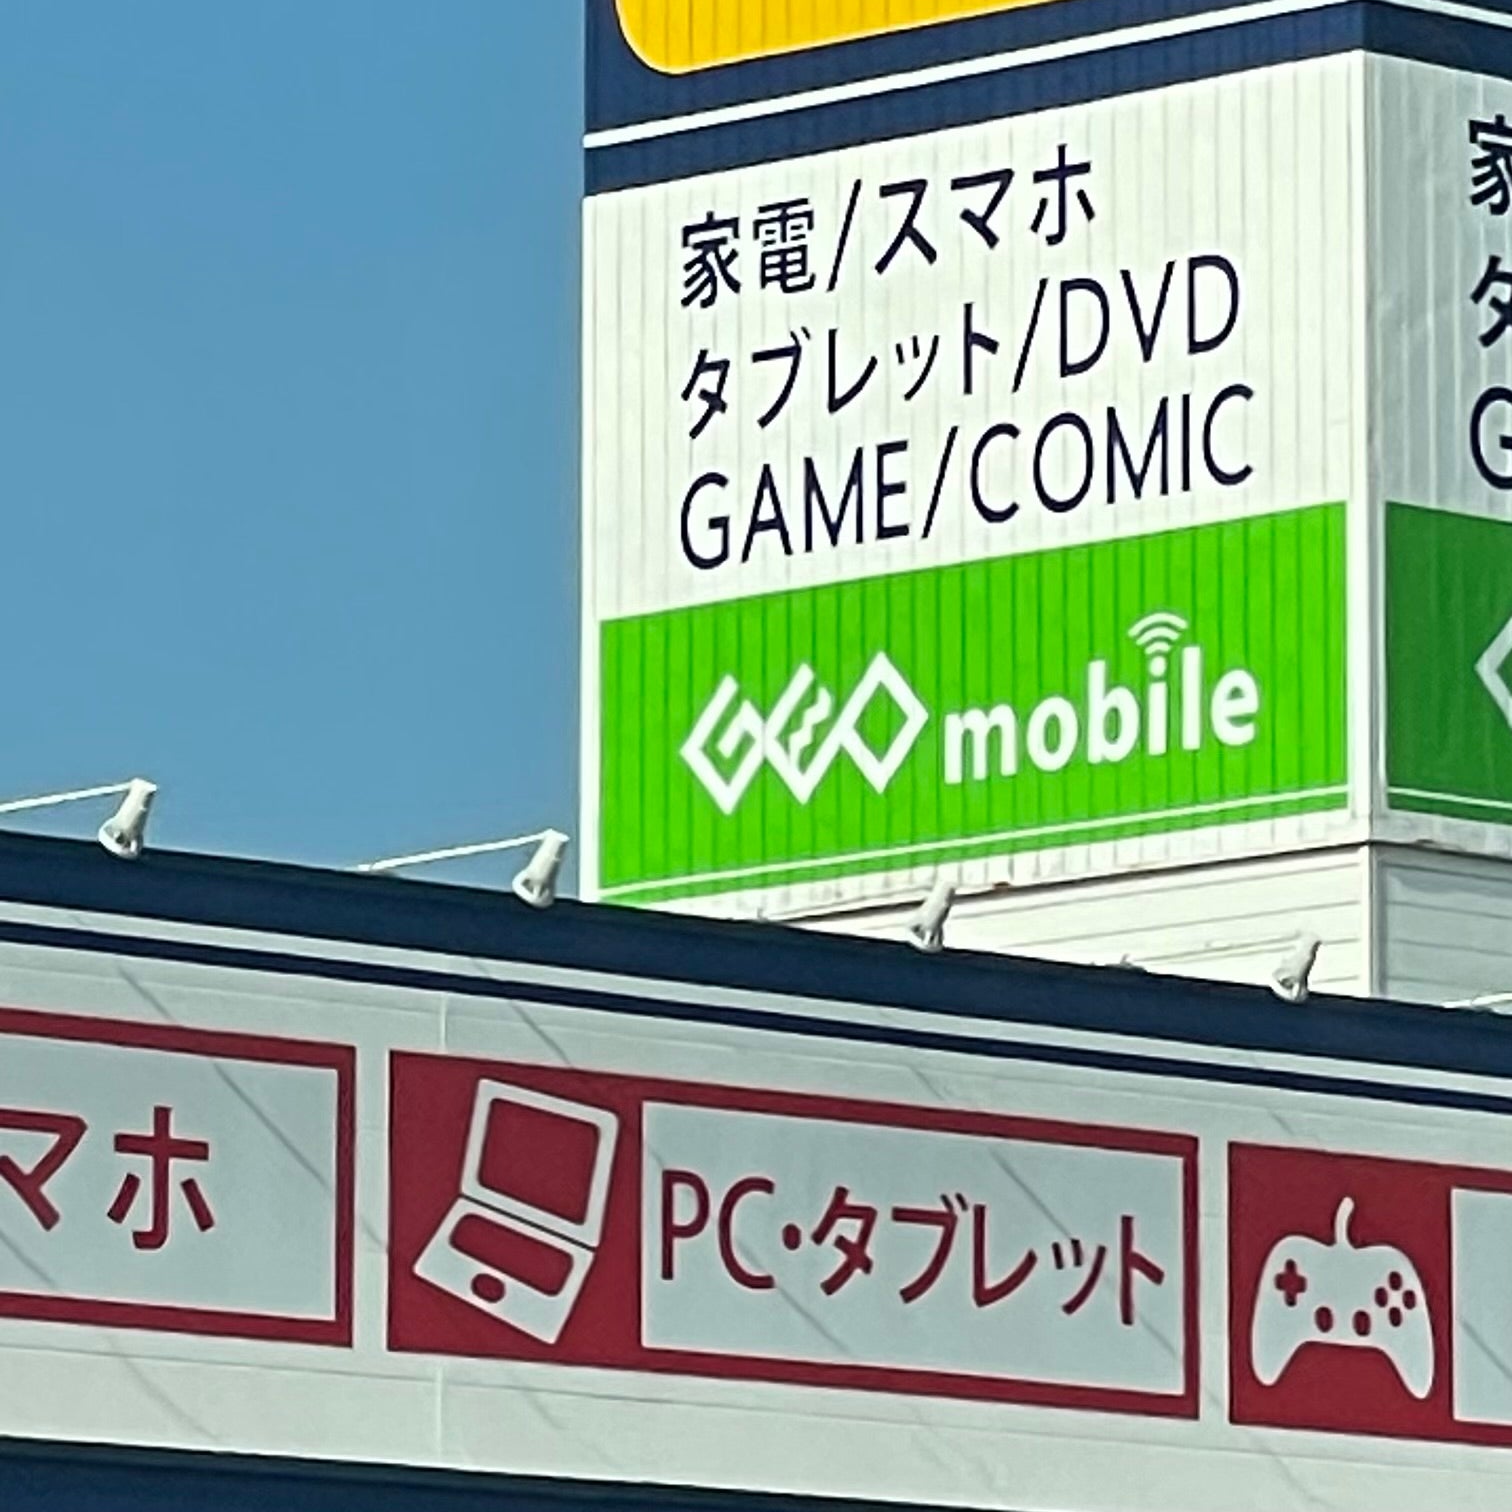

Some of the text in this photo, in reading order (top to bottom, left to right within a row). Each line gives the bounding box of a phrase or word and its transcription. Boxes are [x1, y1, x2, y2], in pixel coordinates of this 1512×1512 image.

[680, 144, 1096, 309] 家電/スマホ
[681, 254, 1241, 440] タブレット/DVD
[680, 383, 1255, 570] GAME/COMIC
[679, 645, 1260, 816] GEO mobile
